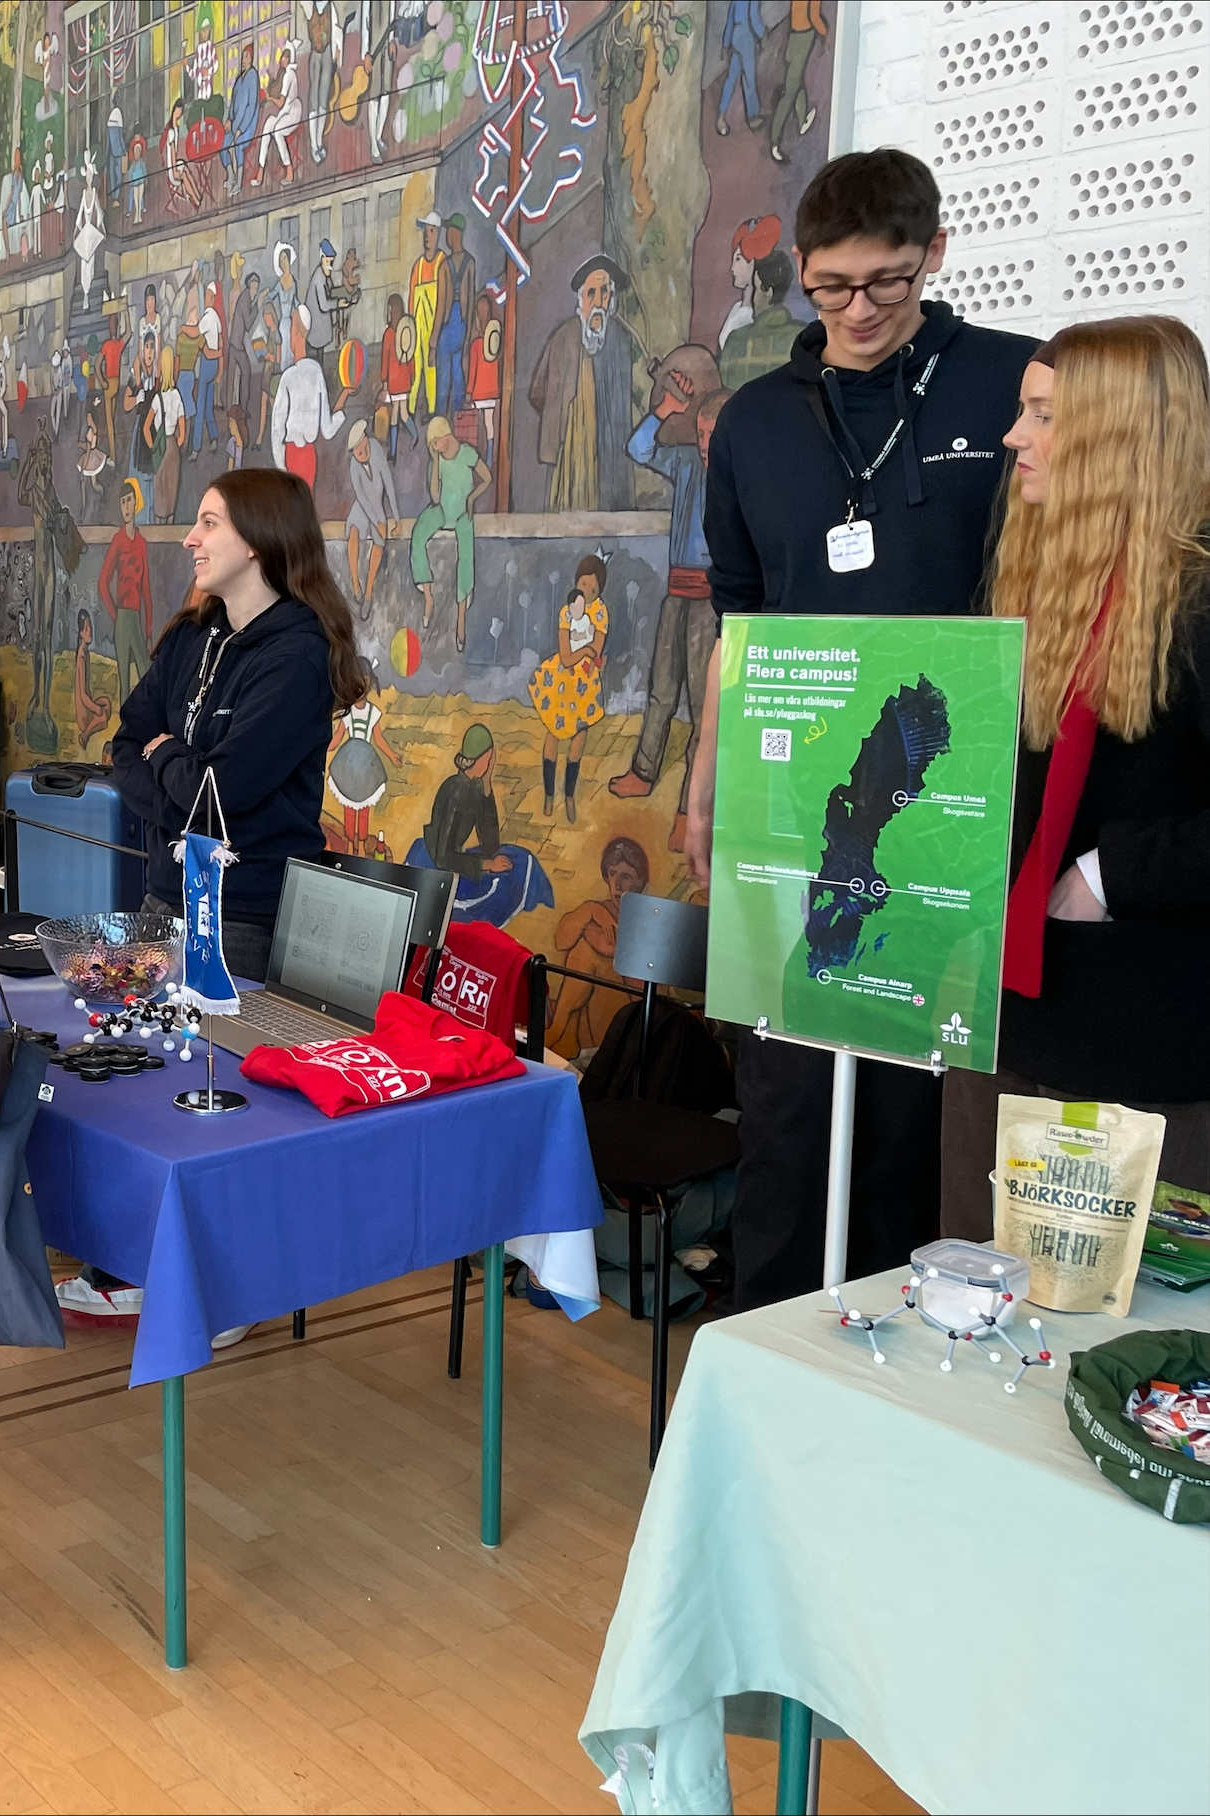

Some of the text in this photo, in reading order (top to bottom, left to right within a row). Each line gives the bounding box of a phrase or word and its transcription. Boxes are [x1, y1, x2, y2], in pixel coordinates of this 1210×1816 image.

[946, 451, 996, 460] UNIVERSITET
[747, 645, 861, 663] Ett universitet.
[746, 663, 857, 684] Flera campus!
[744, 692, 847, 709] Läs mer om våra utbildningar
[743, 706, 817, 722] på slu.se/pluggaskog
[930, 791, 987, 804] Campus Umeå
[907, 882, 971, 897] Campus Uppsala
[922, 897, 970, 910] Skogsekonom
[440, 970, 489, 1009] O Rn
[857, 973, 913, 990] Campus Alnarp
[842, 983, 912, 1002] Forest and Landscape
[941, 1031, 968, 1046] SLU
[1009, 1179, 1137, 1219] BJÖRKSOCKER
